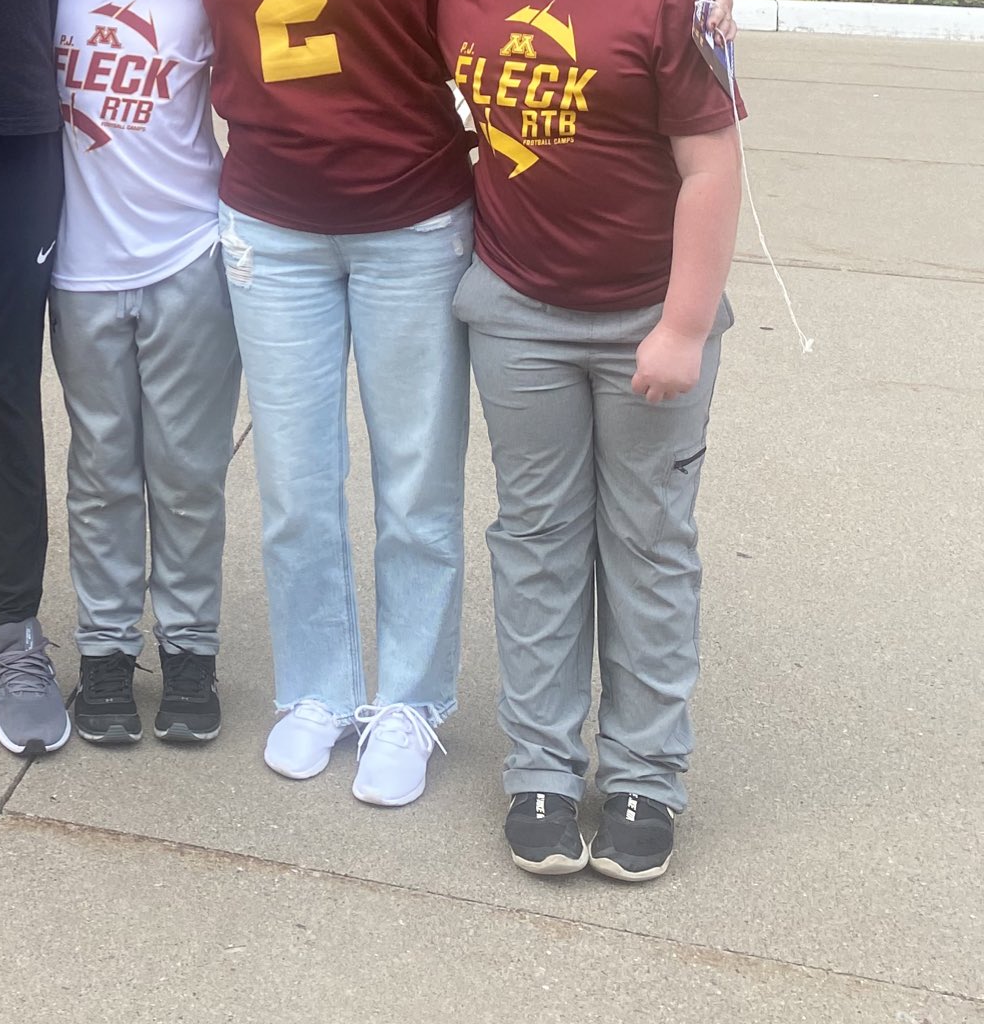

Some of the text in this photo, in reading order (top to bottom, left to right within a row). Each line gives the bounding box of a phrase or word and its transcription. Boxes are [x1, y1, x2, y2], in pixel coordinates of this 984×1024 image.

[86, 25, 122, 49] M
[499, 32, 537, 59] M
[54, 46, 180, 100] FLECK
[454, 55, 598, 112] FLECK
[100, 96, 155, 124] RTB
[521, 109, 577, 138] RTB
[522, 137, 575, 146] FOOTBALL CAMPS
